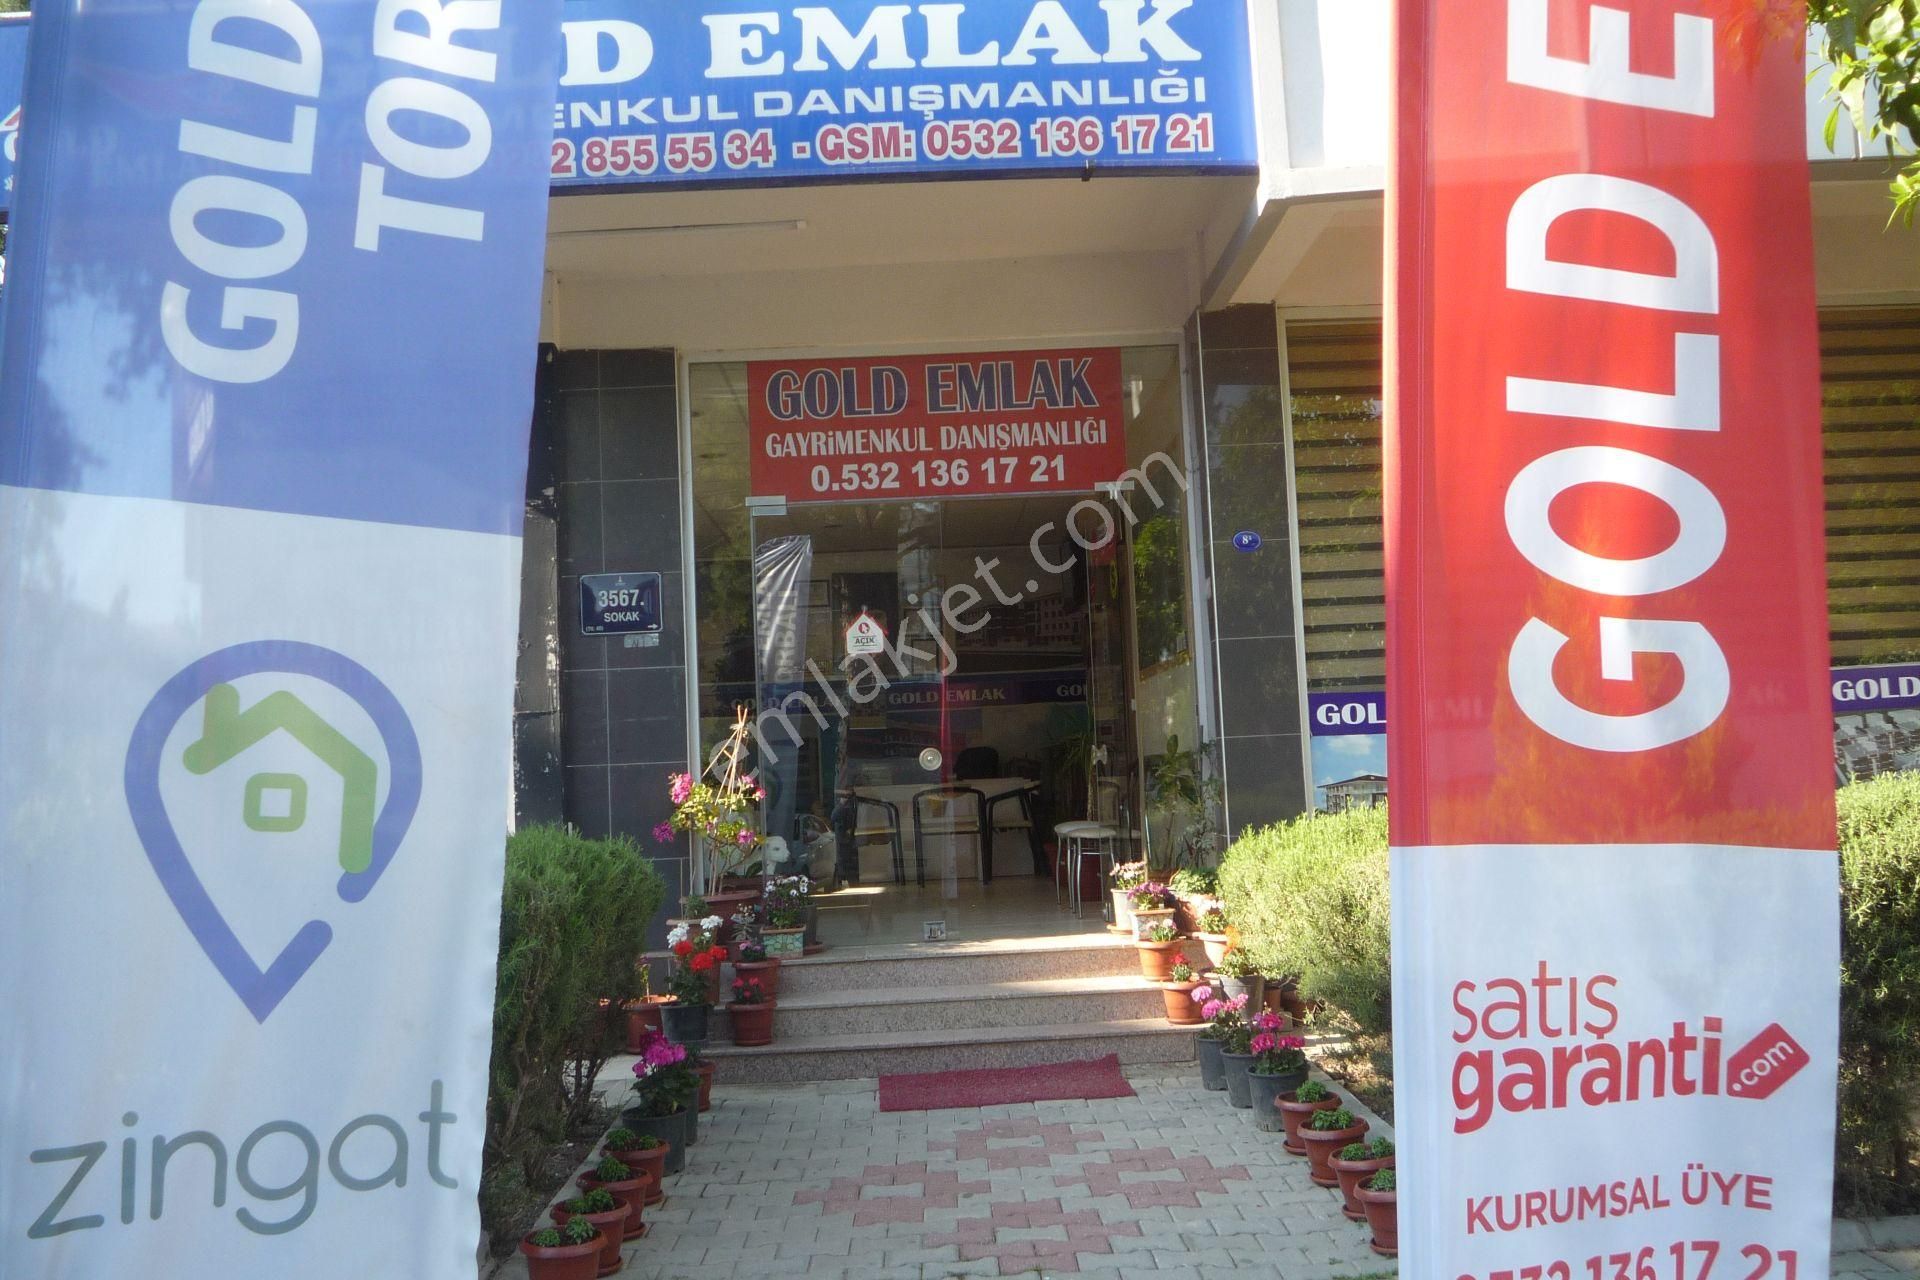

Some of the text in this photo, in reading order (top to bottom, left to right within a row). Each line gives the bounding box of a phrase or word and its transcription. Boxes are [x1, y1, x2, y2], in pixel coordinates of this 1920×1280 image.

[560, 0, 1202, 86] D EMLAK
[754, 69, 1207, 121] DANIŞMANLIĞI
[582, 134, 659, 177] 855
[664, 131, 718, 174] 55
[724, 128, 774, 170] 34
[815, 122, 914, 164] GSM:
[924, 118, 1019, 160] 0532
[1030, 115, 1102, 157] 136
[1112, 113, 1159, 155] 17
[1166, 112, 1214, 153] 21
[160, 0, 323, 385] GOLD
[766, 357, 1100, 421] GOLD EMLAK
[939, 416, 1108, 452] DANIŞMANLIĞI
[1504, 173, 1731, 752] GOLD
[811, 454, 1065, 493] 0.532 136 17 21
[598, 588, 645, 608] 3567.
[603, 611, 640, 623] SOKAK
[888, 687, 1006, 705] GOLD EMLAK
[1831, 676, 1920, 702] GOLD
[1452, 960, 1619, 1043] satış
[27, 1079, 459, 1239] zingat
[1466, 1163, 1774, 1235] KURUMSAL ÜYE
[1669, 1240, 1720, 1280] 17
[1740, 1243, 1798, 1280] 21
